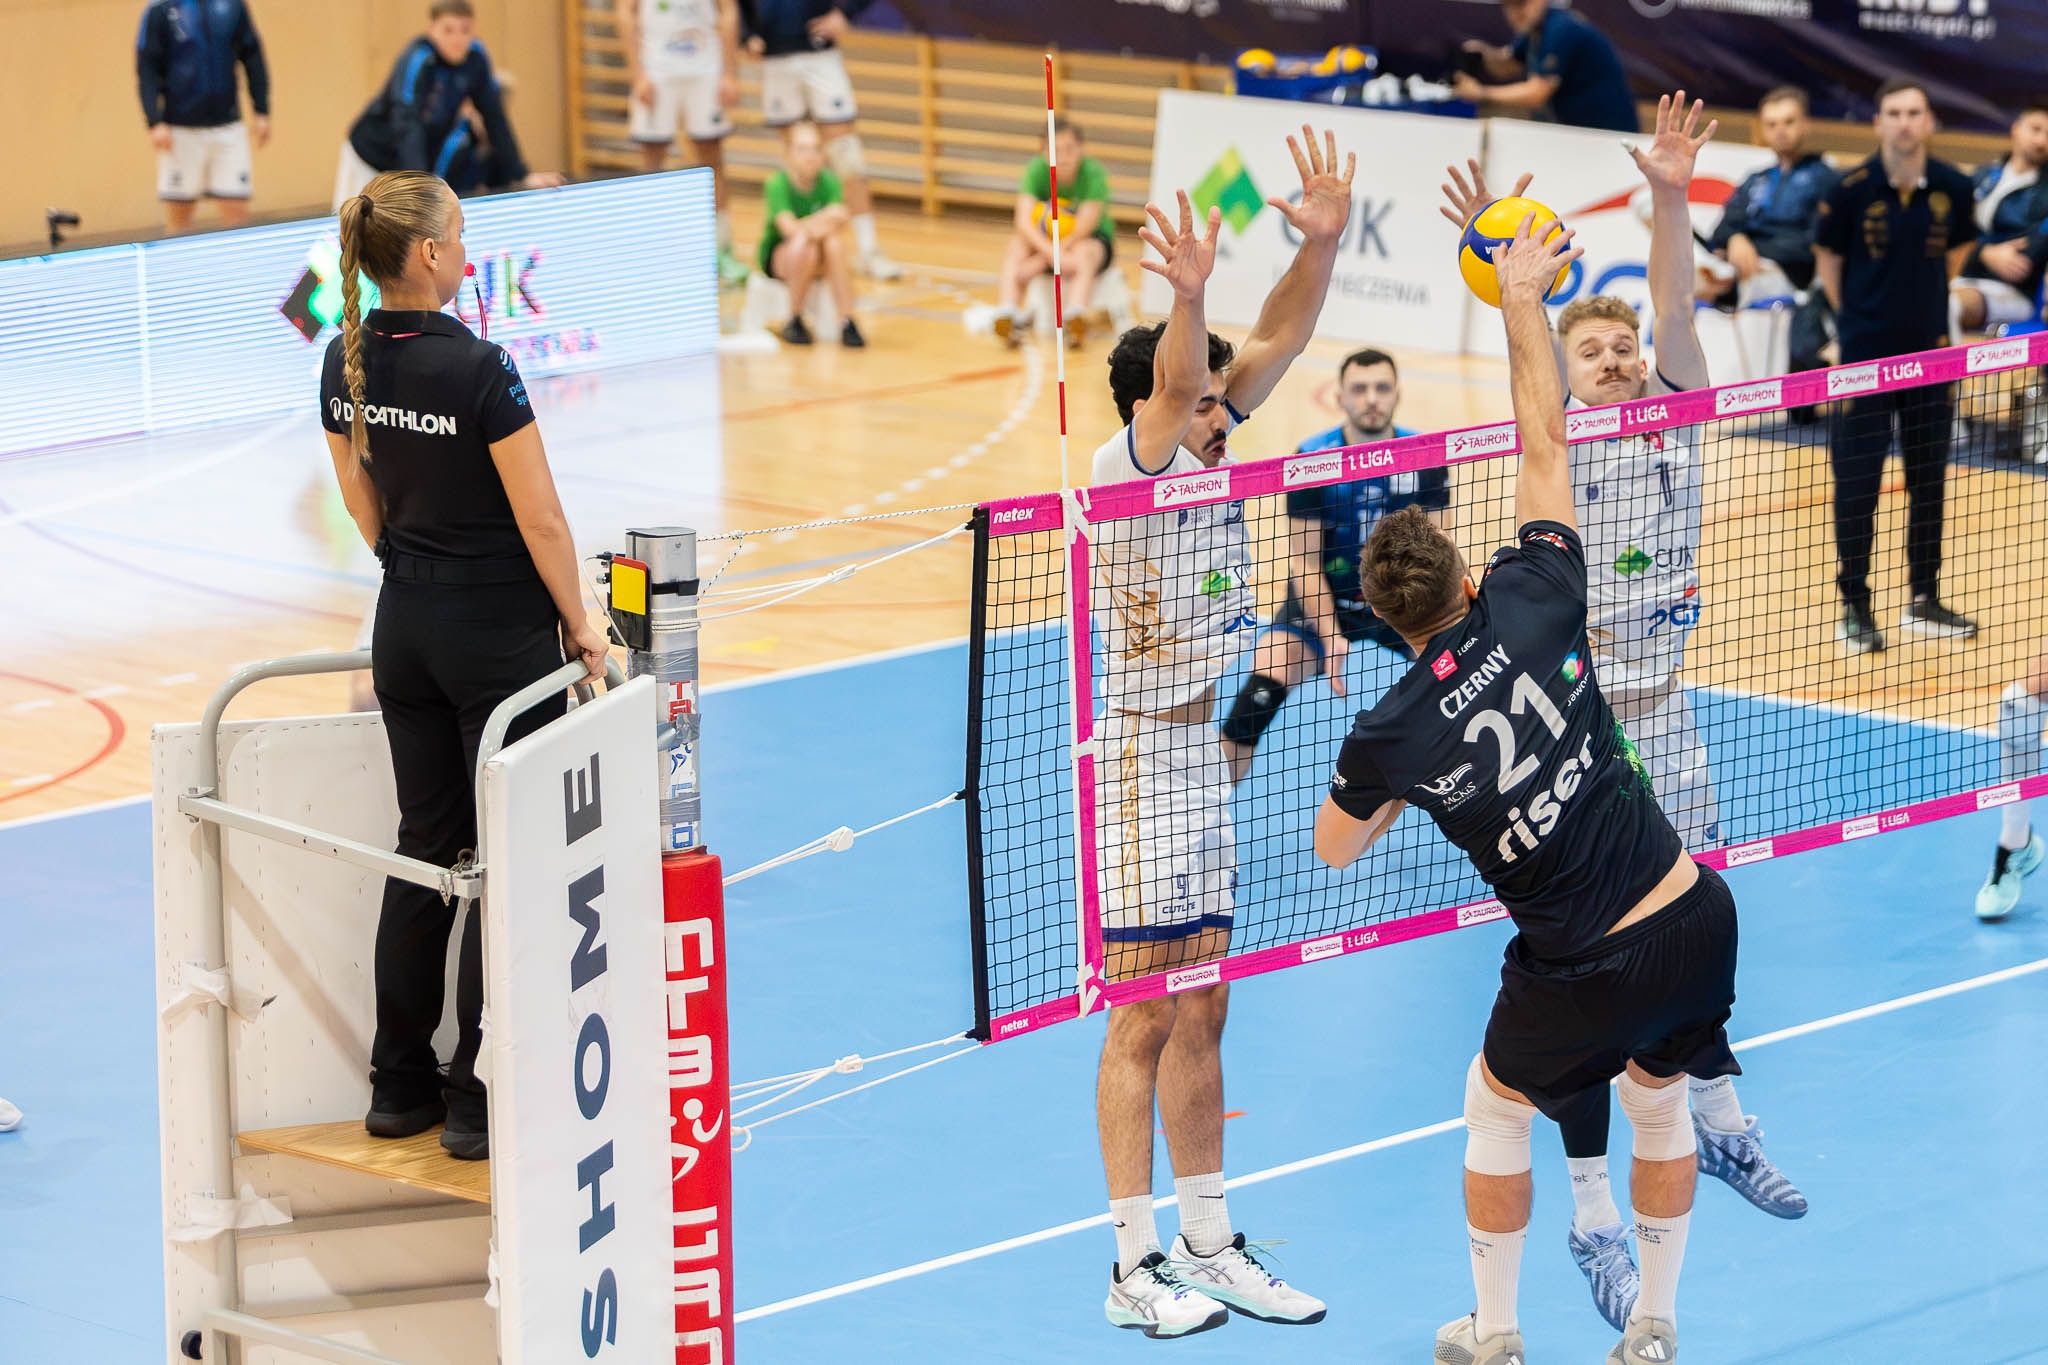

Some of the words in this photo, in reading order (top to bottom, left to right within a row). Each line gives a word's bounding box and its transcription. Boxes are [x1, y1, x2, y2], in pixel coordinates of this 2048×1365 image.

[1891, 361, 1924, 380] LIGA
[1738, 388, 1776, 404] TAURON
[1585, 415, 1618, 429] TAURON
[1636, 403, 1669, 423] LIGA
[1469, 432, 1509, 449] TAURON
[1303, 461, 1339, 477] TAURON
[1360, 449, 1394, 468] LIGA
[1178, 479, 1223, 496] TAURON
[993, 506, 1035, 524] netex
[1461, 637, 1479, 652] LIGA
[1440, 644, 1511, 719] CZERNY
[1463, 672, 1567, 794] 21
[1498, 732, 1593, 863] riser
[1473, 905, 1502, 919] TAURON
[1354, 931, 1380, 947] LIGA
[1183, 968, 1217, 984] TAURON
[1000, 1017, 1029, 1034] netex
